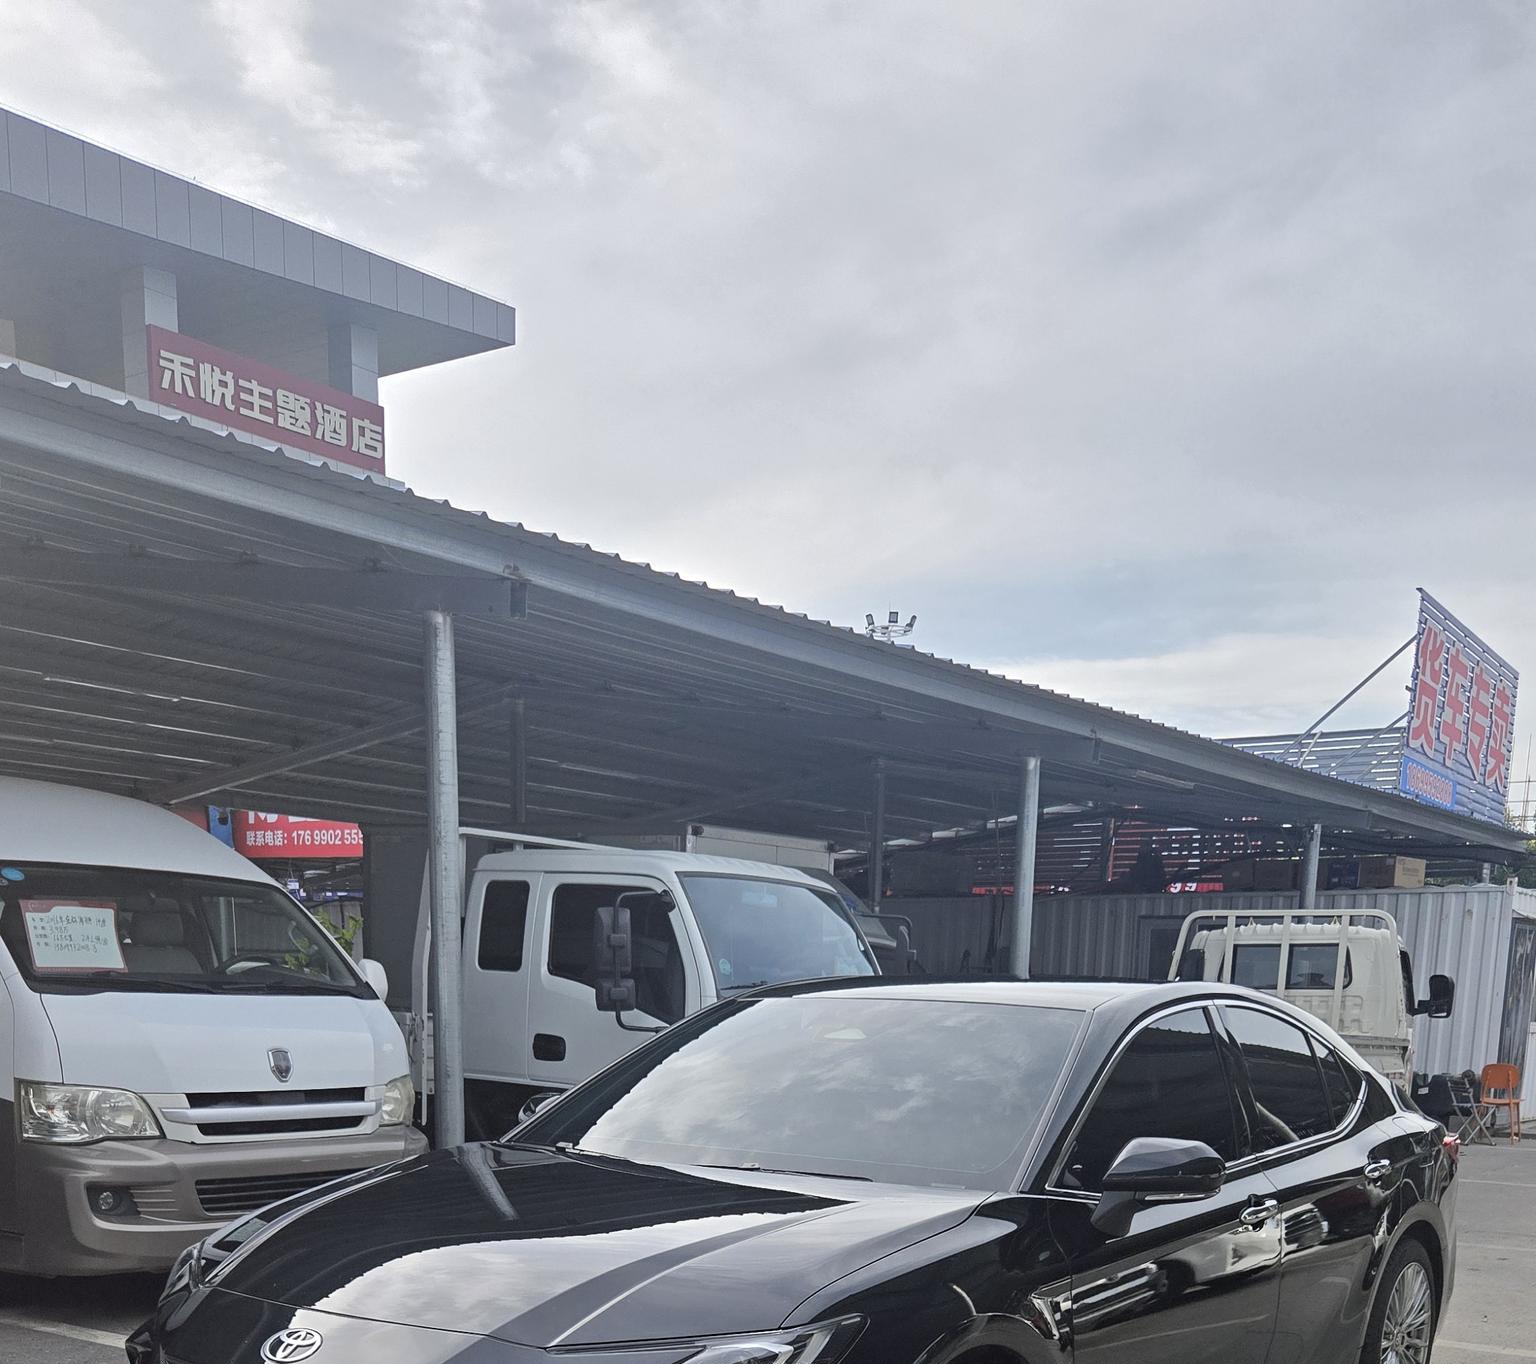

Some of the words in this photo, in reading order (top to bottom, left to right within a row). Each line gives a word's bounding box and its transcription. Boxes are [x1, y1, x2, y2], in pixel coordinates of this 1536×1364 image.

[159, 349, 384, 459] 禾悦主题酒店
[1410, 620, 1510, 794] 货车专卖
[313, 830, 342, 845] 9902
